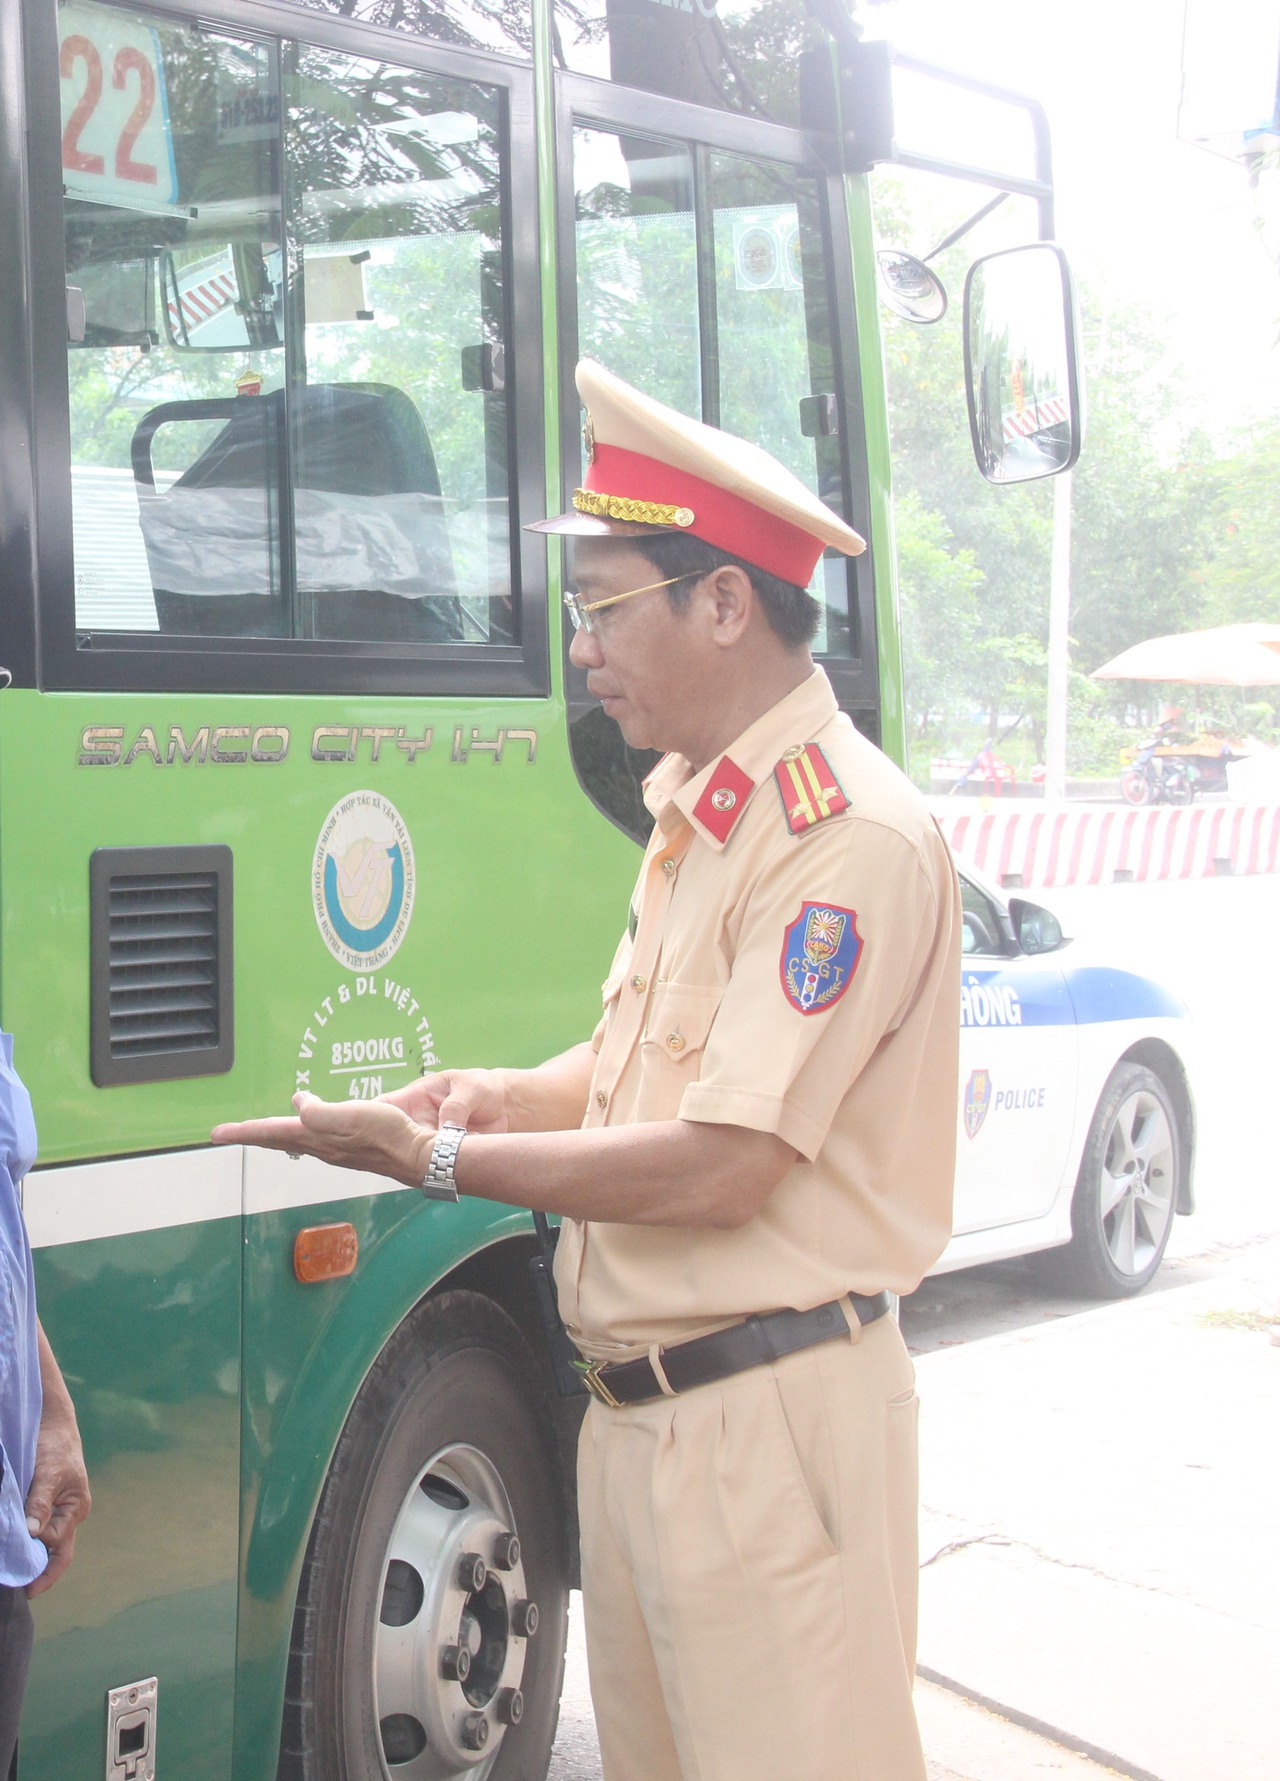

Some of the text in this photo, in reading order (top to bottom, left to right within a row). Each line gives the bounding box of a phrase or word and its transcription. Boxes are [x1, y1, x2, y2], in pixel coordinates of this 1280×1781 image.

[77, 725, 291, 767] SAMCO
[310, 725, 433, 764] CITY
[298, 1027, 318, 1059] VT
[314, 996, 334, 1027] LT
[338, 983, 351, 1003] &
[356, 975, 377, 996] DL
[384, 978, 420, 1017] VIỆT
[331, 1036, 404, 1066] 8500KG
[348, 1076, 382, 1100] 47N
[995, 1088, 1046, 1111] POLICE
